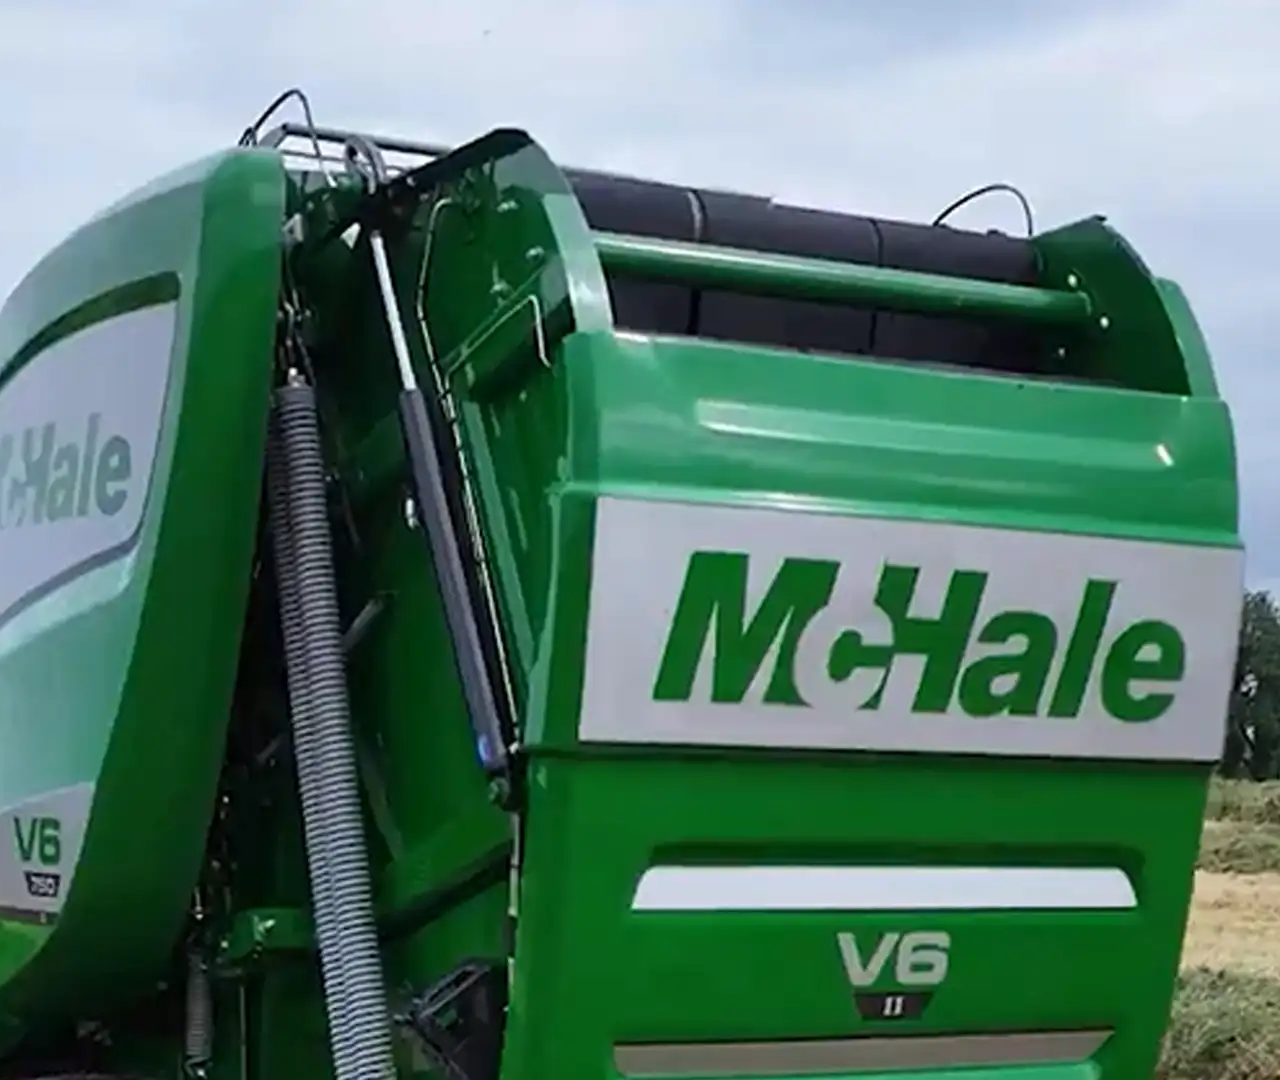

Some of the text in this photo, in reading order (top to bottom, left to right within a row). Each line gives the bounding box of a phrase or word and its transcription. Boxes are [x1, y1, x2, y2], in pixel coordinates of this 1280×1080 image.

[652, 550, 1186, 722] McHale
[13, 816, 61, 866] V6
[836, 931, 951, 986] V6
